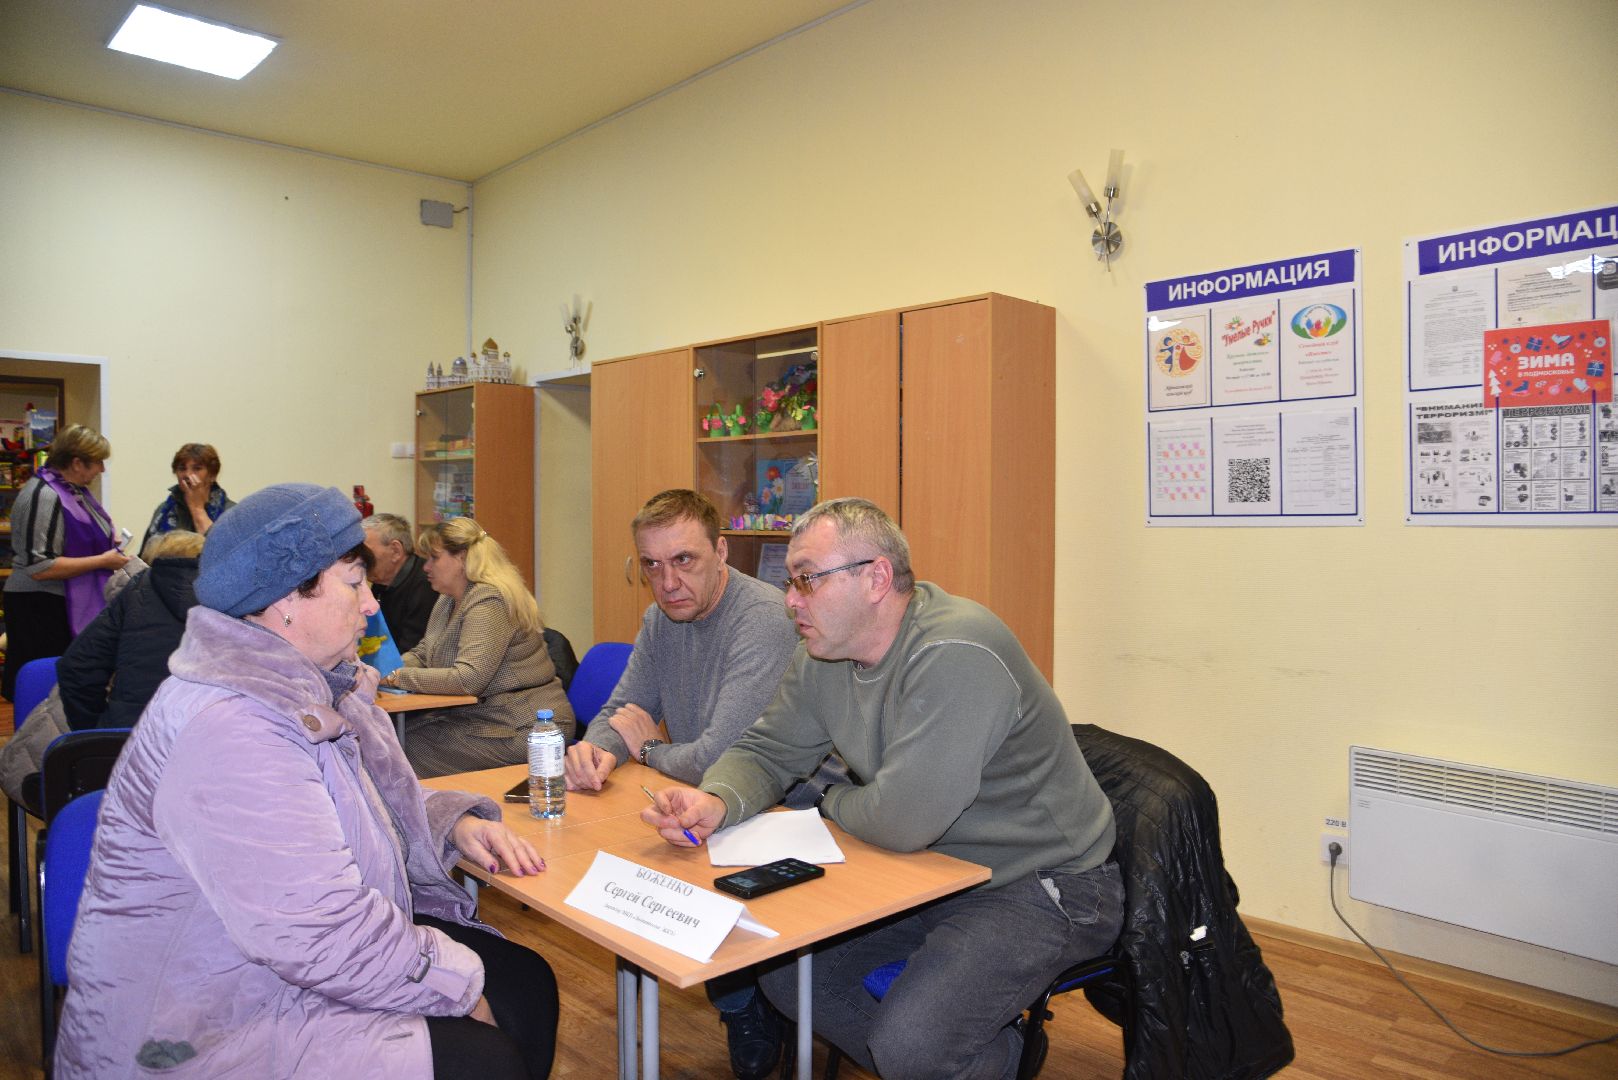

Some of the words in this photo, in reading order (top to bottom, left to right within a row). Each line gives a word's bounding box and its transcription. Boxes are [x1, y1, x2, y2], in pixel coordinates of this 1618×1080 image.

[1438, 214, 1618, 264] ИНФОРМАЦ
[1168, 259, 1330, 301] ИНФОРМАЦИЯ
[1518, 352, 1575, 370] ЗИМА
[1325, 819, 1340, 827] 220
[635, 867, 694, 898] БОЖЕНКО
[604, 881, 640, 904] Сергей
[641, 895, 700, 929] Сергеевич
